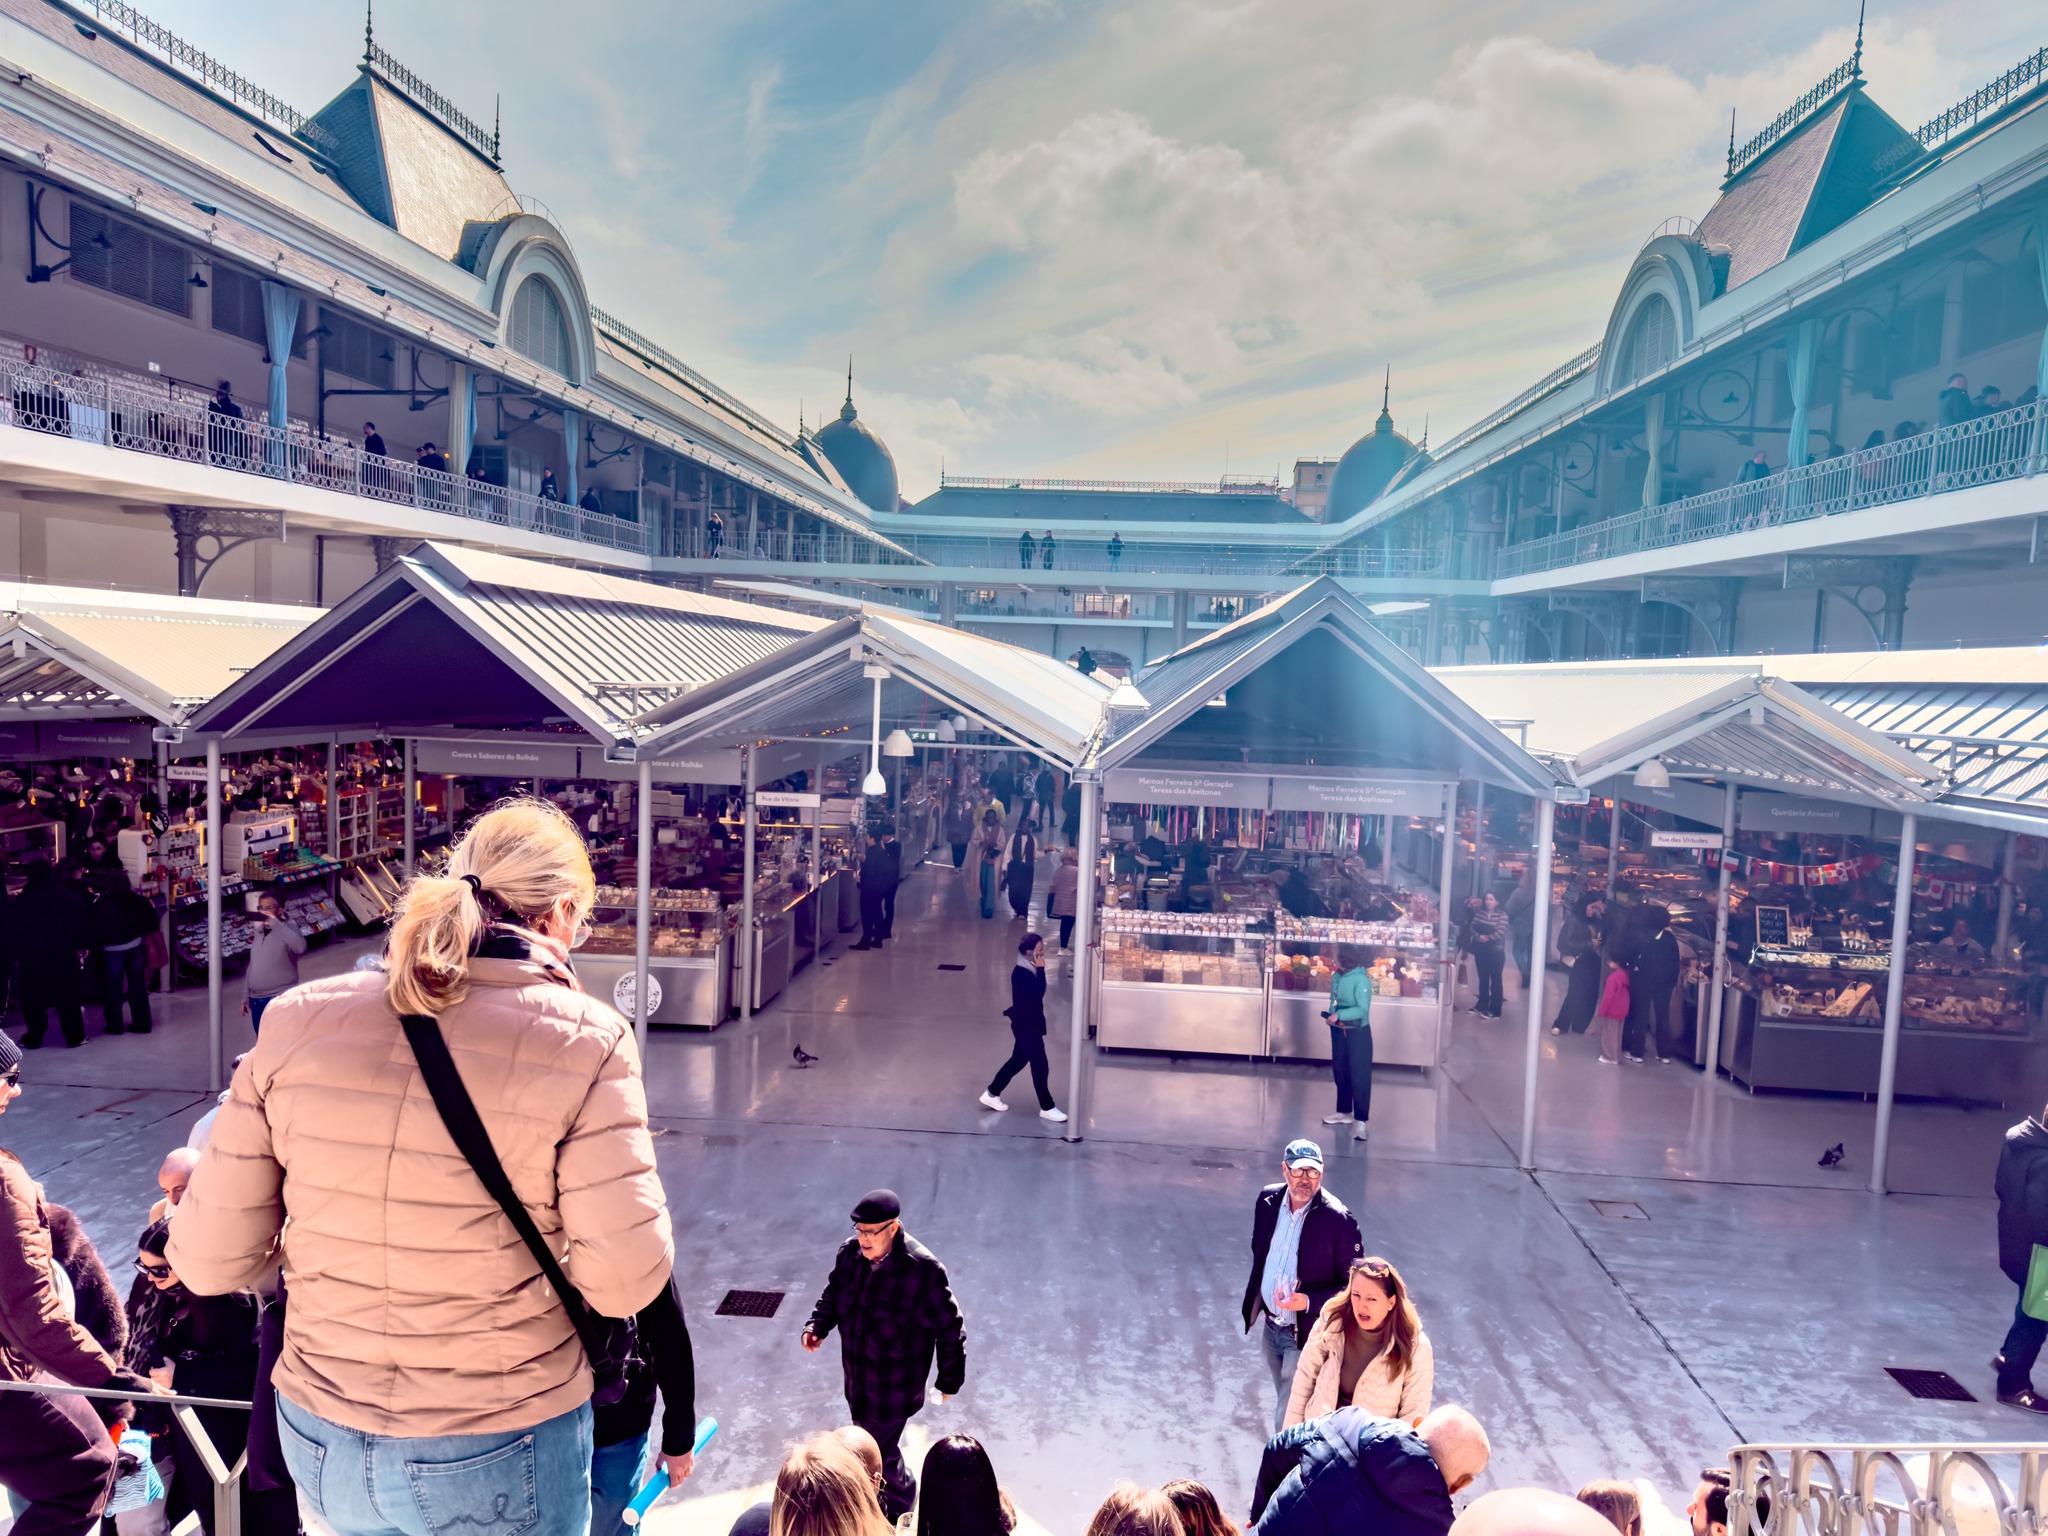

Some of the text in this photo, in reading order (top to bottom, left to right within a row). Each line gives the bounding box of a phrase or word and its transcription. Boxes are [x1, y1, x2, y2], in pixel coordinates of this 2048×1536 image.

[452, 751, 472, 759] Cores
[479, 752, 505, 760] Sabores
[1138, 777, 1164, 785] Marcos
[1165, 778, 1193, 786] Ferreira
[1203, 780, 1234, 789] Geração
[1150, 786, 1222, 796] Teresa das Azeitonas
[1308, 784, 1334, 792] Marcos
[1336, 785, 1364, 794] Ferreira
[1375, 787, 1406, 796] Geração
[1320, 793, 1393, 804] Teresa das Azeitonas
